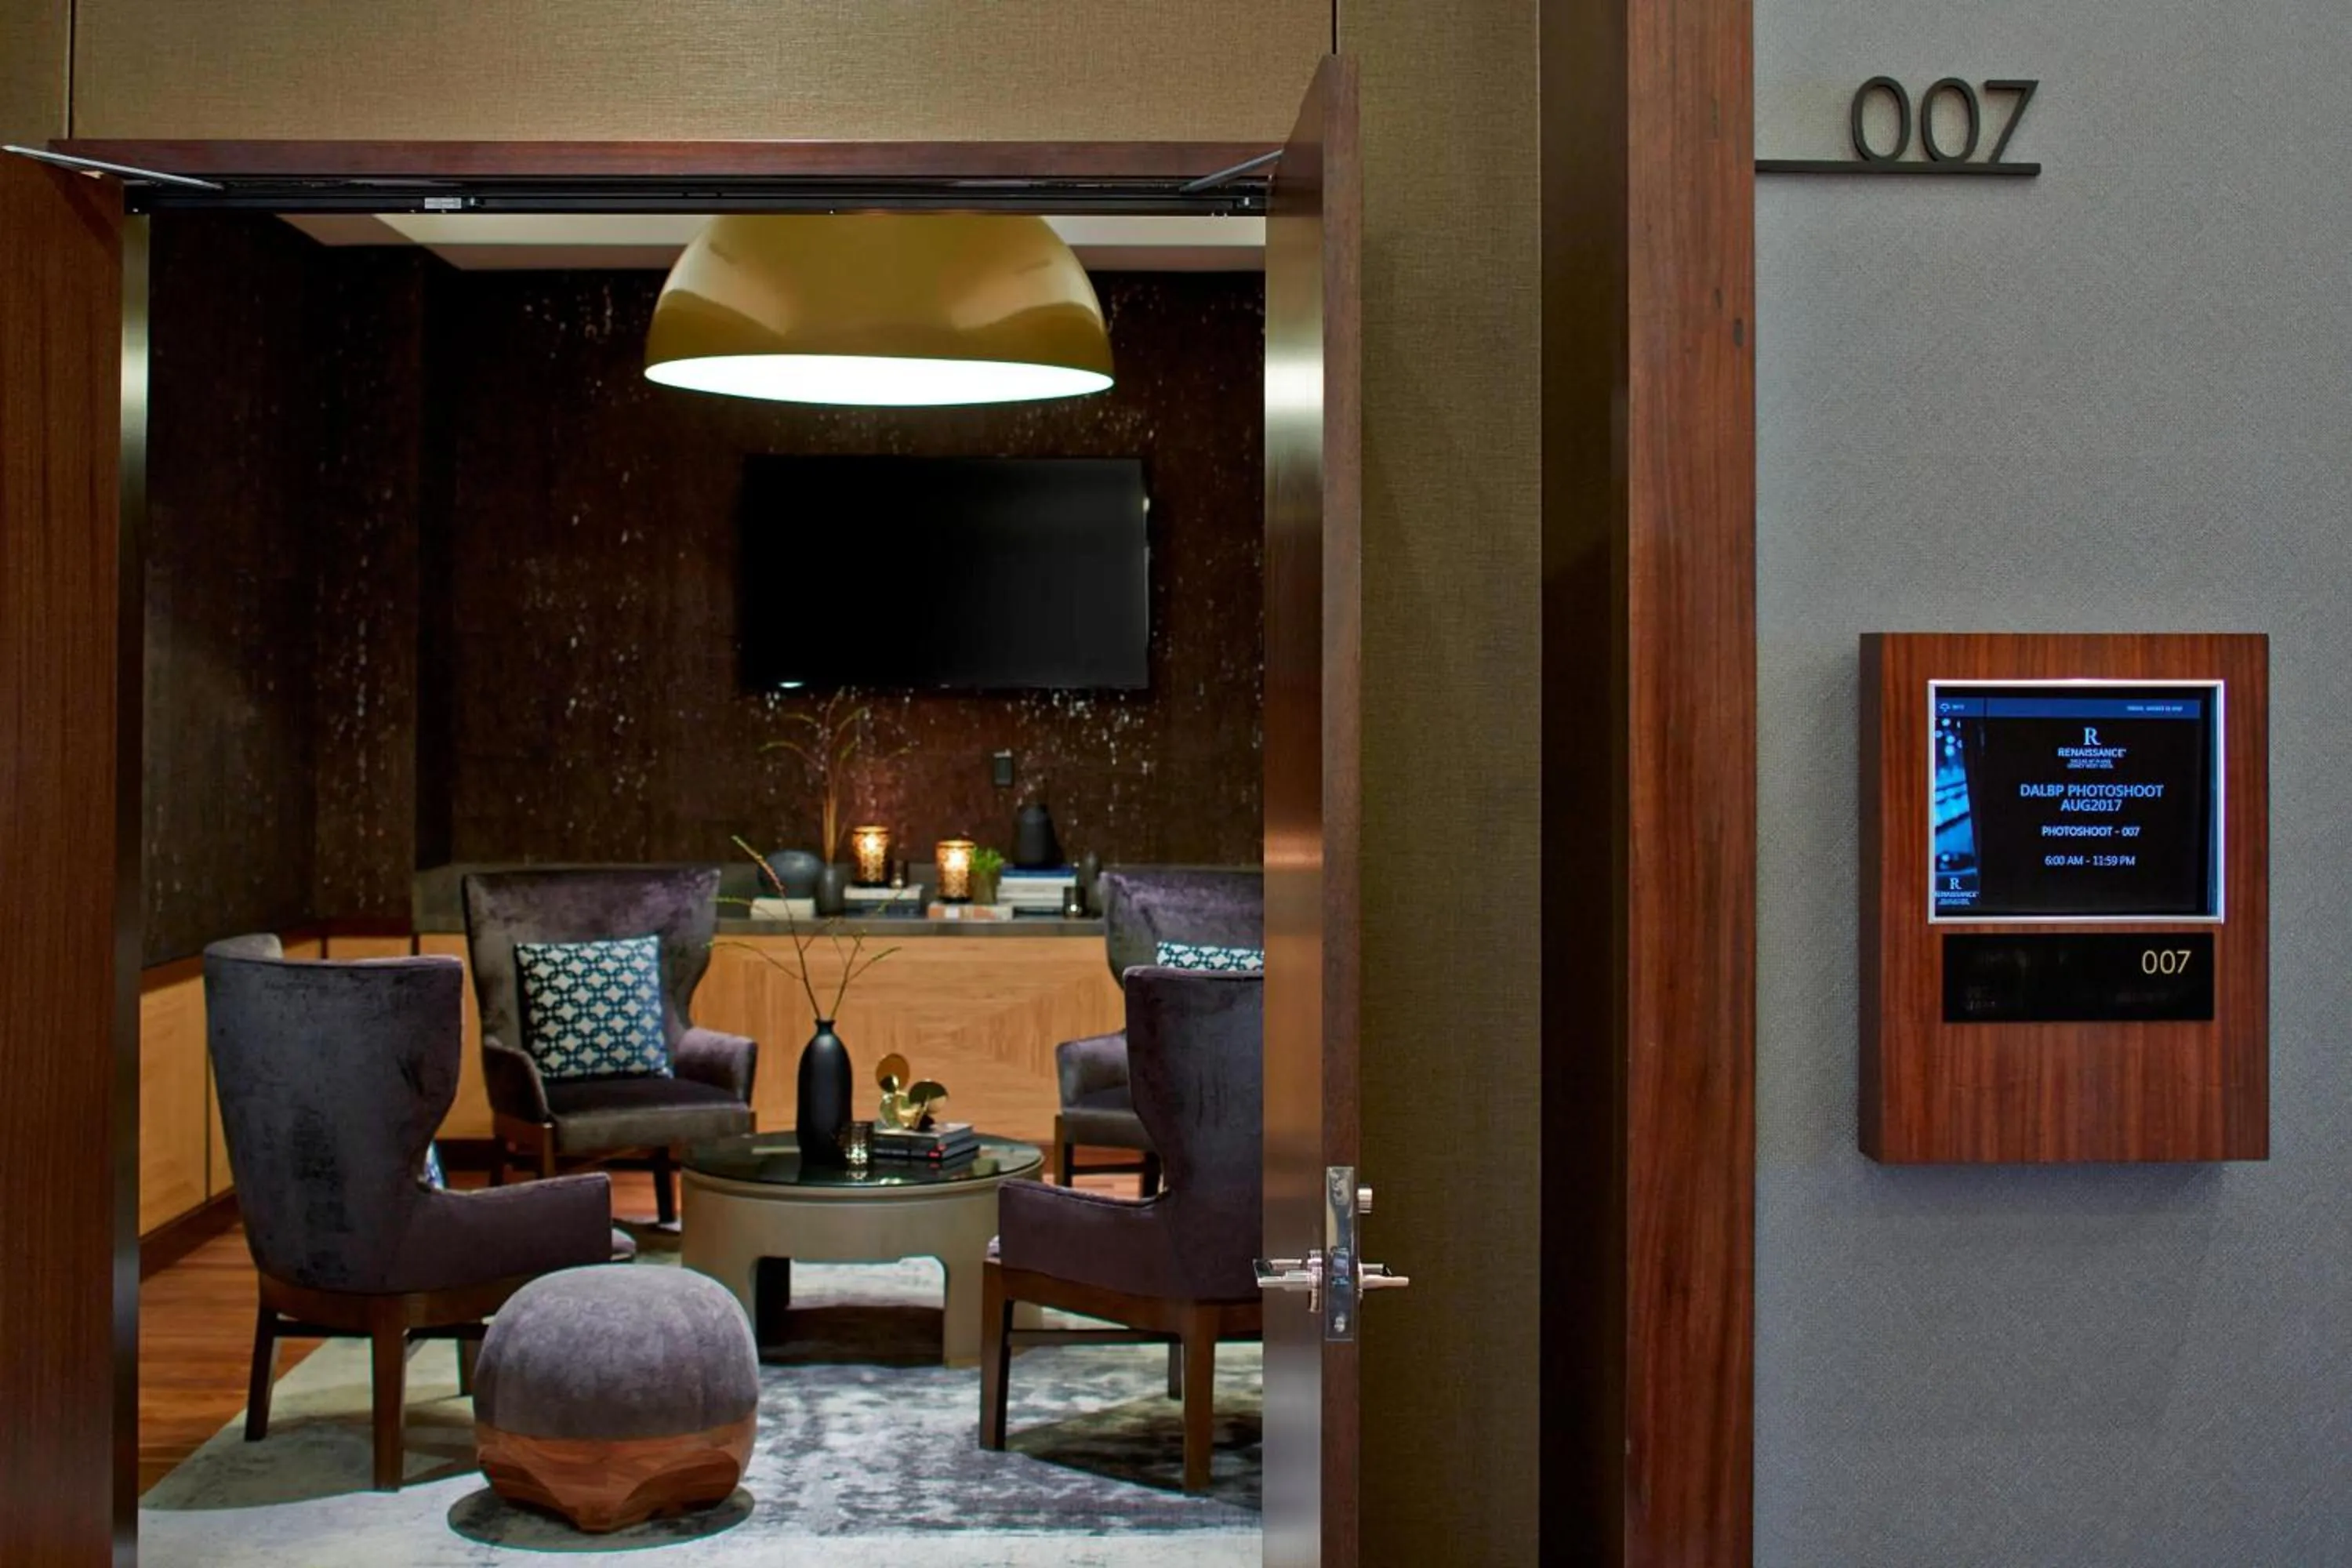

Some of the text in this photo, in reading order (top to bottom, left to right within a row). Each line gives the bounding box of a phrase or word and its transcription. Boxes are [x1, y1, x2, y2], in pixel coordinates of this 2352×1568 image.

[1851, 75, 2039, 164] 007
[2083, 727, 2101, 746] R
[2057, 747, 2125, 758] RENAISSANCE
[2020, 784, 2165, 797] DALBP PHOTOSHOOT
[2060, 799, 2122, 812] AUG2017
[2042, 826, 2113, 837] PHOTOSHOOT
[2122, 826, 2140, 837] 007
[2045, 855, 2065, 866] 6:00
[2067, 855, 2084, 866] AM
[2092, 855, 2118, 866] 11:59
[2119, 855, 2136, 866] PM
[1950, 877, 1962, 890] R
[2142, 949, 2191, 975] 007
